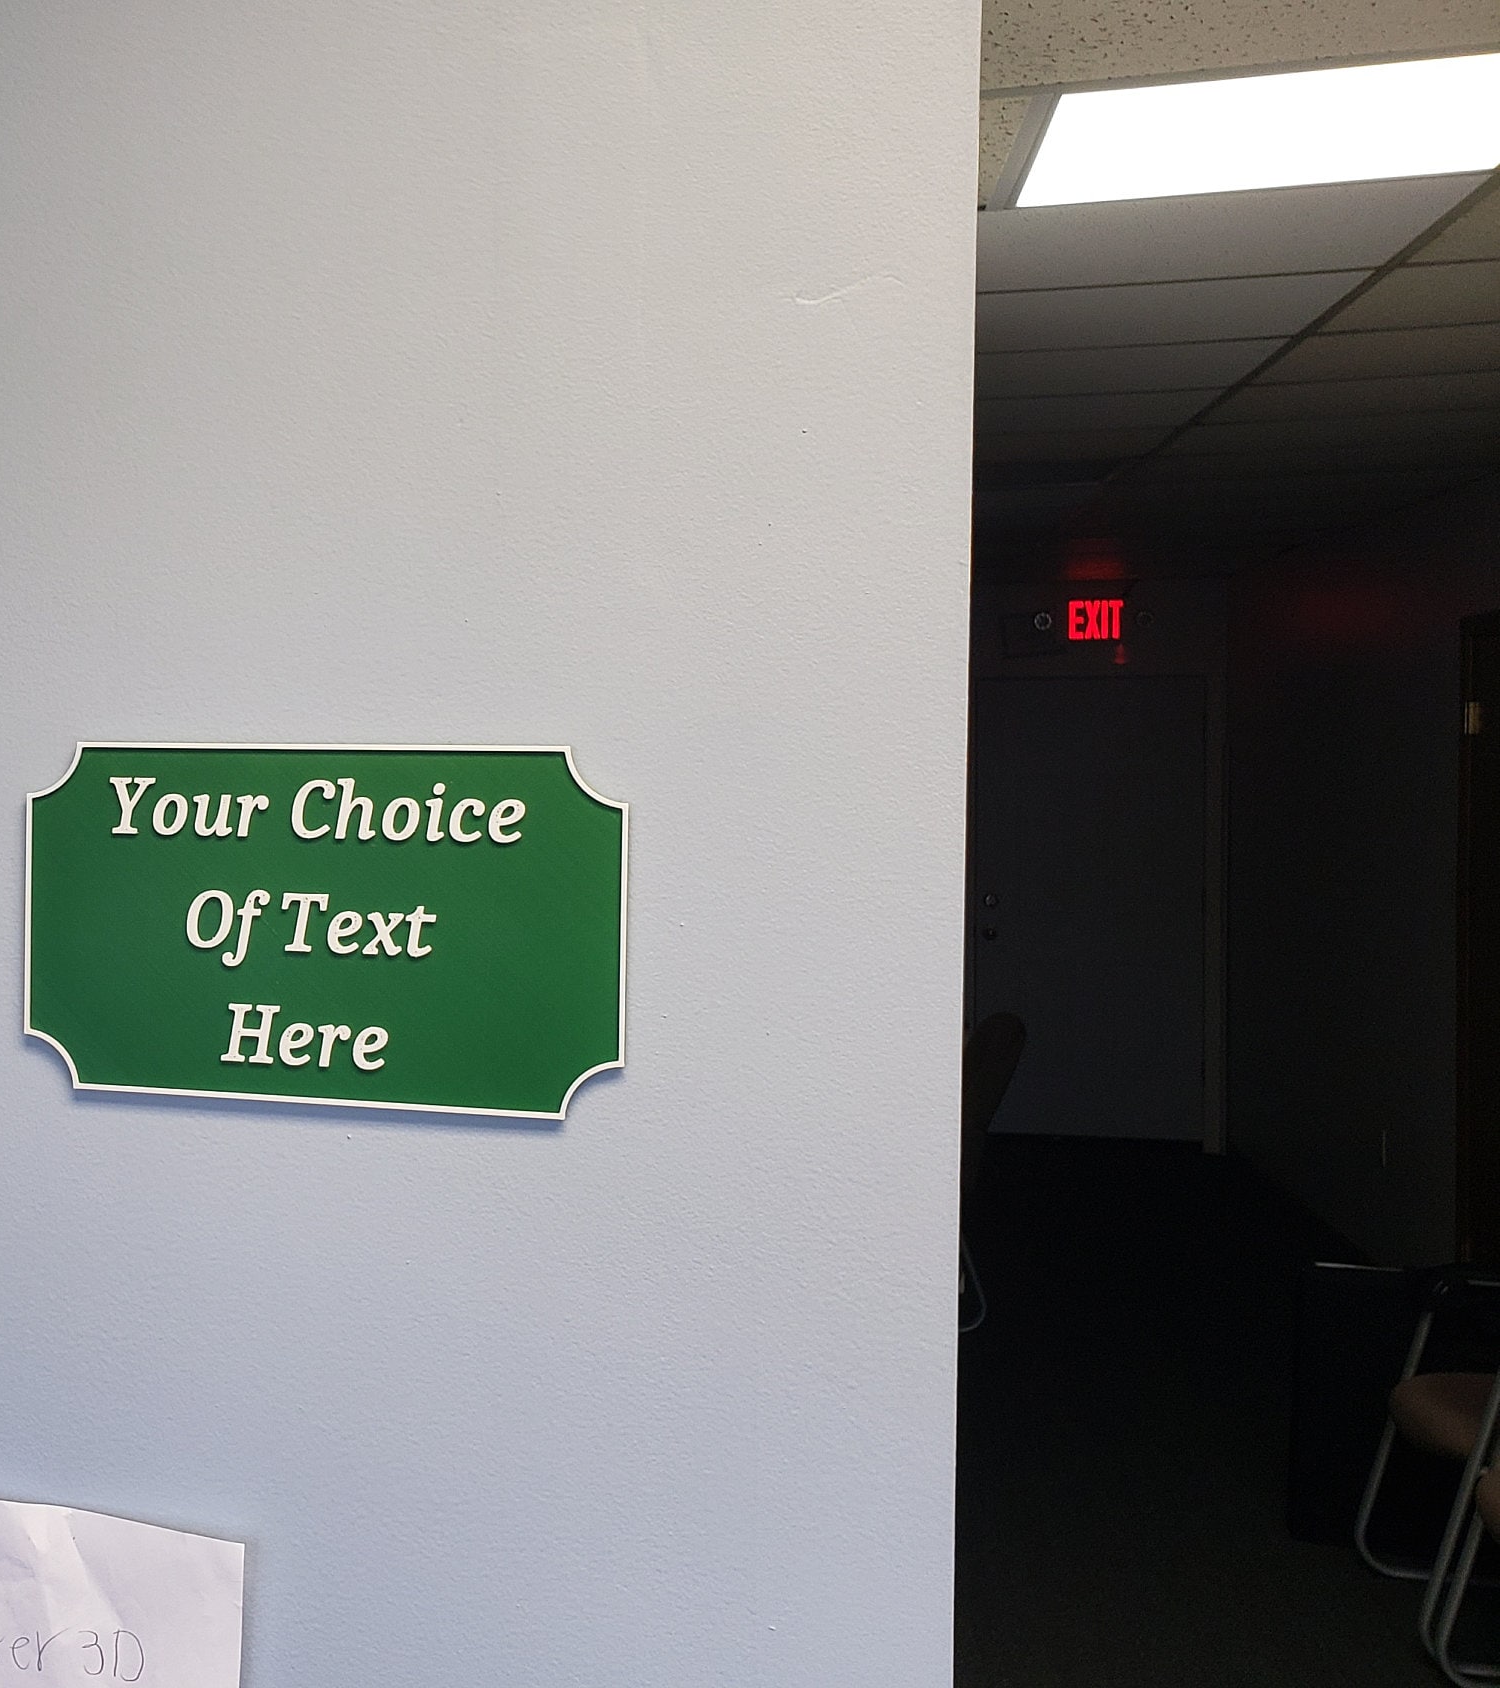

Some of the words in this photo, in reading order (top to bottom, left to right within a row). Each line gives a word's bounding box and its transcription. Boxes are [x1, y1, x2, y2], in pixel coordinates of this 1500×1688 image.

[1068, 599, 1124, 640] EXIT
[109, 776, 269, 838] Your
[290, 777, 526, 844] Choice
[185, 889, 270, 967] Of
[281, 893, 437, 959] Text
[219, 1002, 389, 1071] Here
[77, 1629, 145, 1682] 3D
